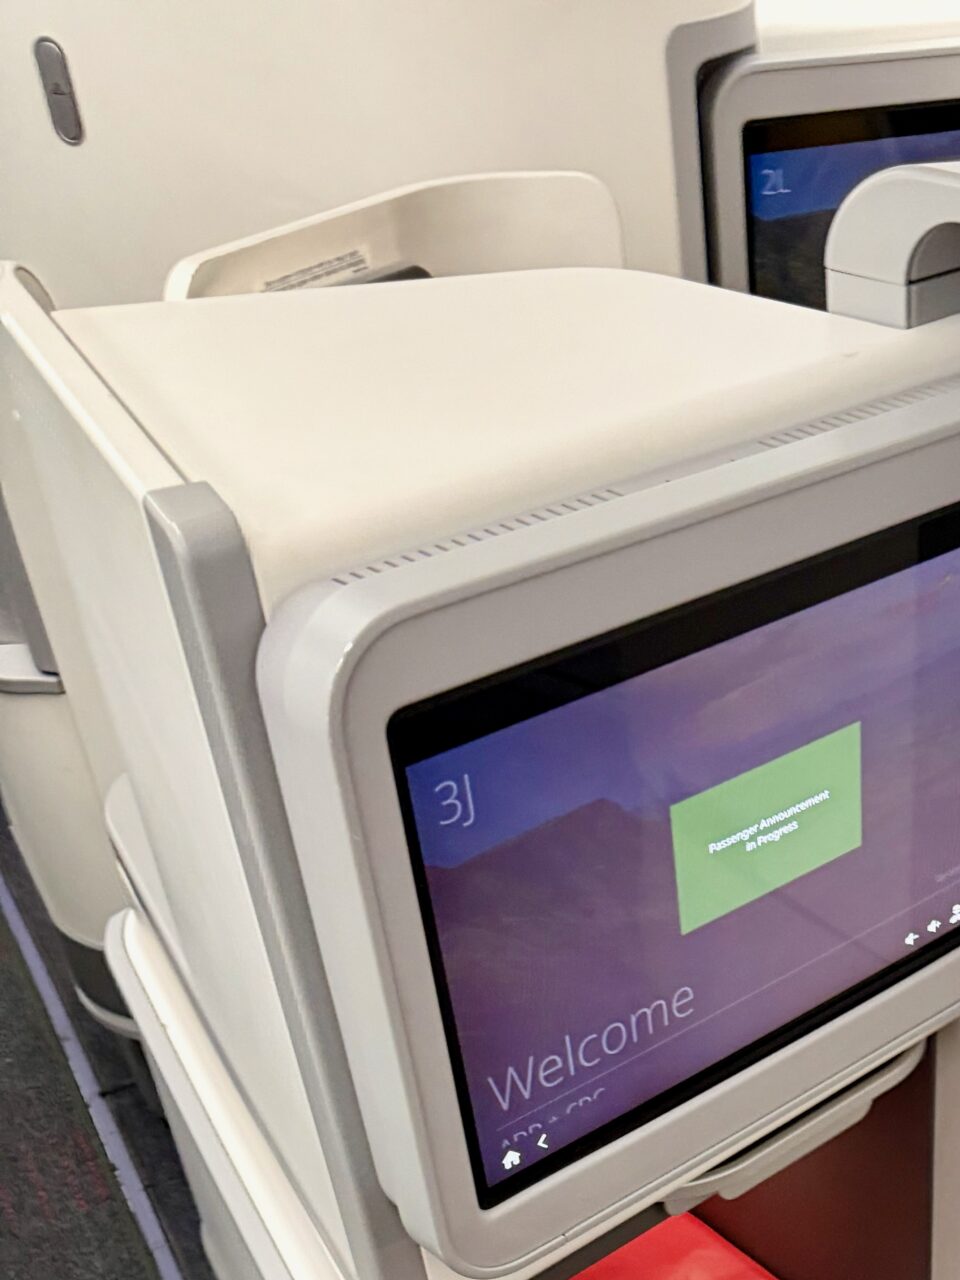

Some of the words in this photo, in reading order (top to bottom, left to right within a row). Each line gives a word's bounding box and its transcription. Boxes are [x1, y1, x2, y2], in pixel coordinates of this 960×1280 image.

[761, 168, 792, 195] 2L
[434, 773, 475, 828] 3J
[708, 824, 759, 854] Passenger
[759, 789, 830, 830] Announcement
[757, 820, 799, 847] Progress
[487, 985, 696, 1113] Welcome
